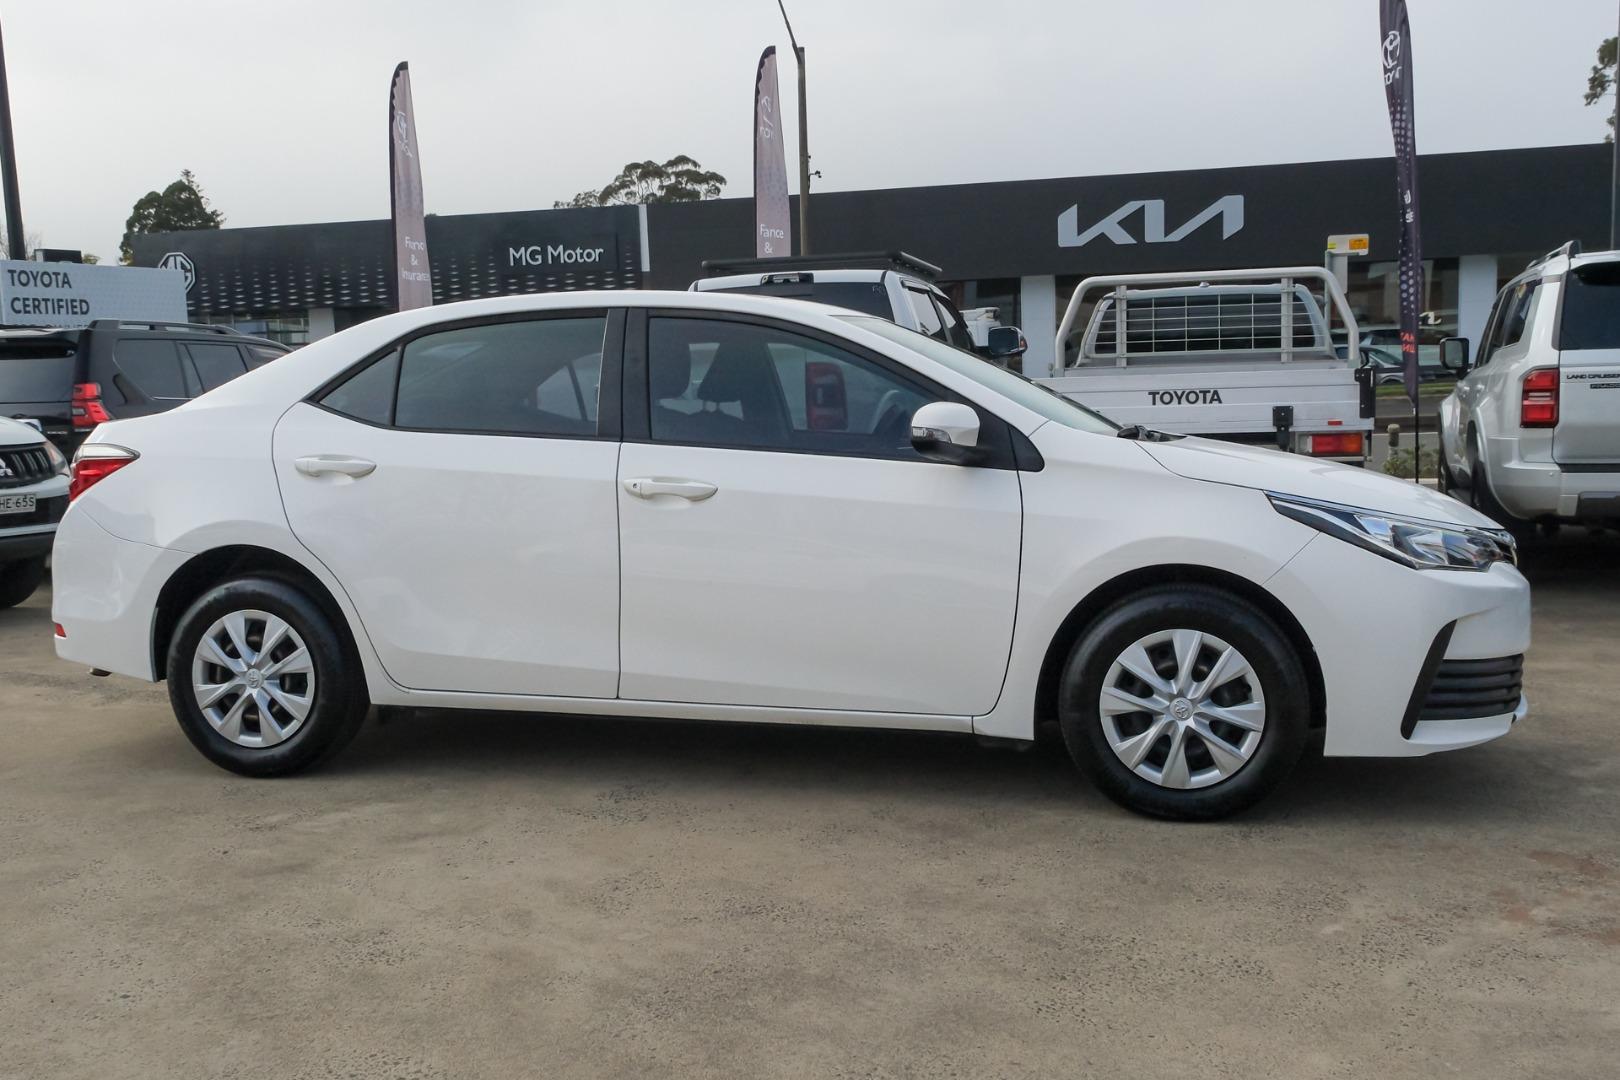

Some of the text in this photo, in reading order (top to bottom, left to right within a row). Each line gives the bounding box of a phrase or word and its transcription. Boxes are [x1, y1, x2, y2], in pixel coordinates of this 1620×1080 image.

[1058, 195, 1245, 248] KIA
[508, 244, 604, 267] MG Motor
[764, 241, 773, 254] &
[7, 269, 73, 289] TOYOTA
[10, 296, 90, 316] CERTIFIED
[1148, 389, 1223, 406] TOYOTA
